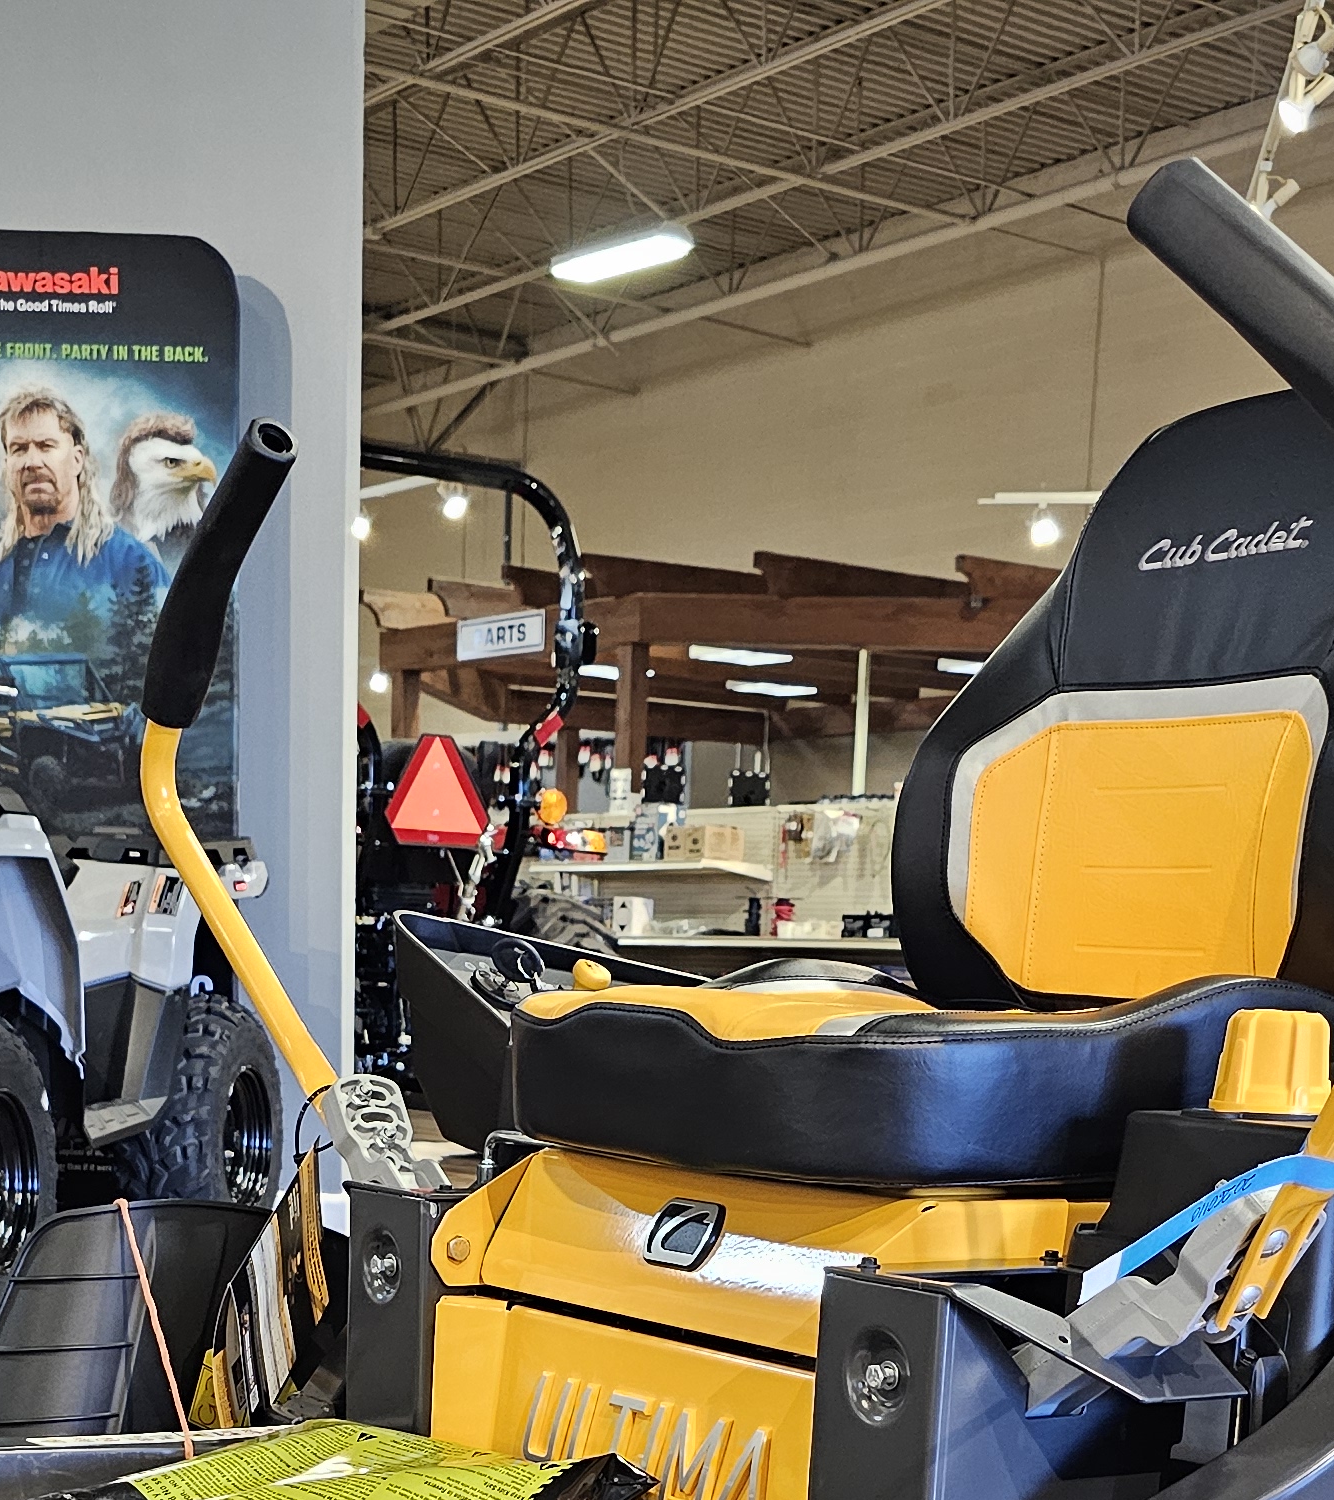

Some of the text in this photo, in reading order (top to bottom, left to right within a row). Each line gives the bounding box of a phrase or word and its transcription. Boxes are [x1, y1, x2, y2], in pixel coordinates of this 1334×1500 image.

[17, 299, 48, 312] Good
[51, 300, 87, 313] Times
[6, 343, 57, 359] FRONT.
[61, 345, 108, 360] PARTY
[113, 346, 128, 360] IN
[133, 346, 160, 361] THE
[164, 346, 209, 363] BACK.
[1138, 516, 1315, 572] Cub Cadet
[474, 622, 526, 647] ARTS
